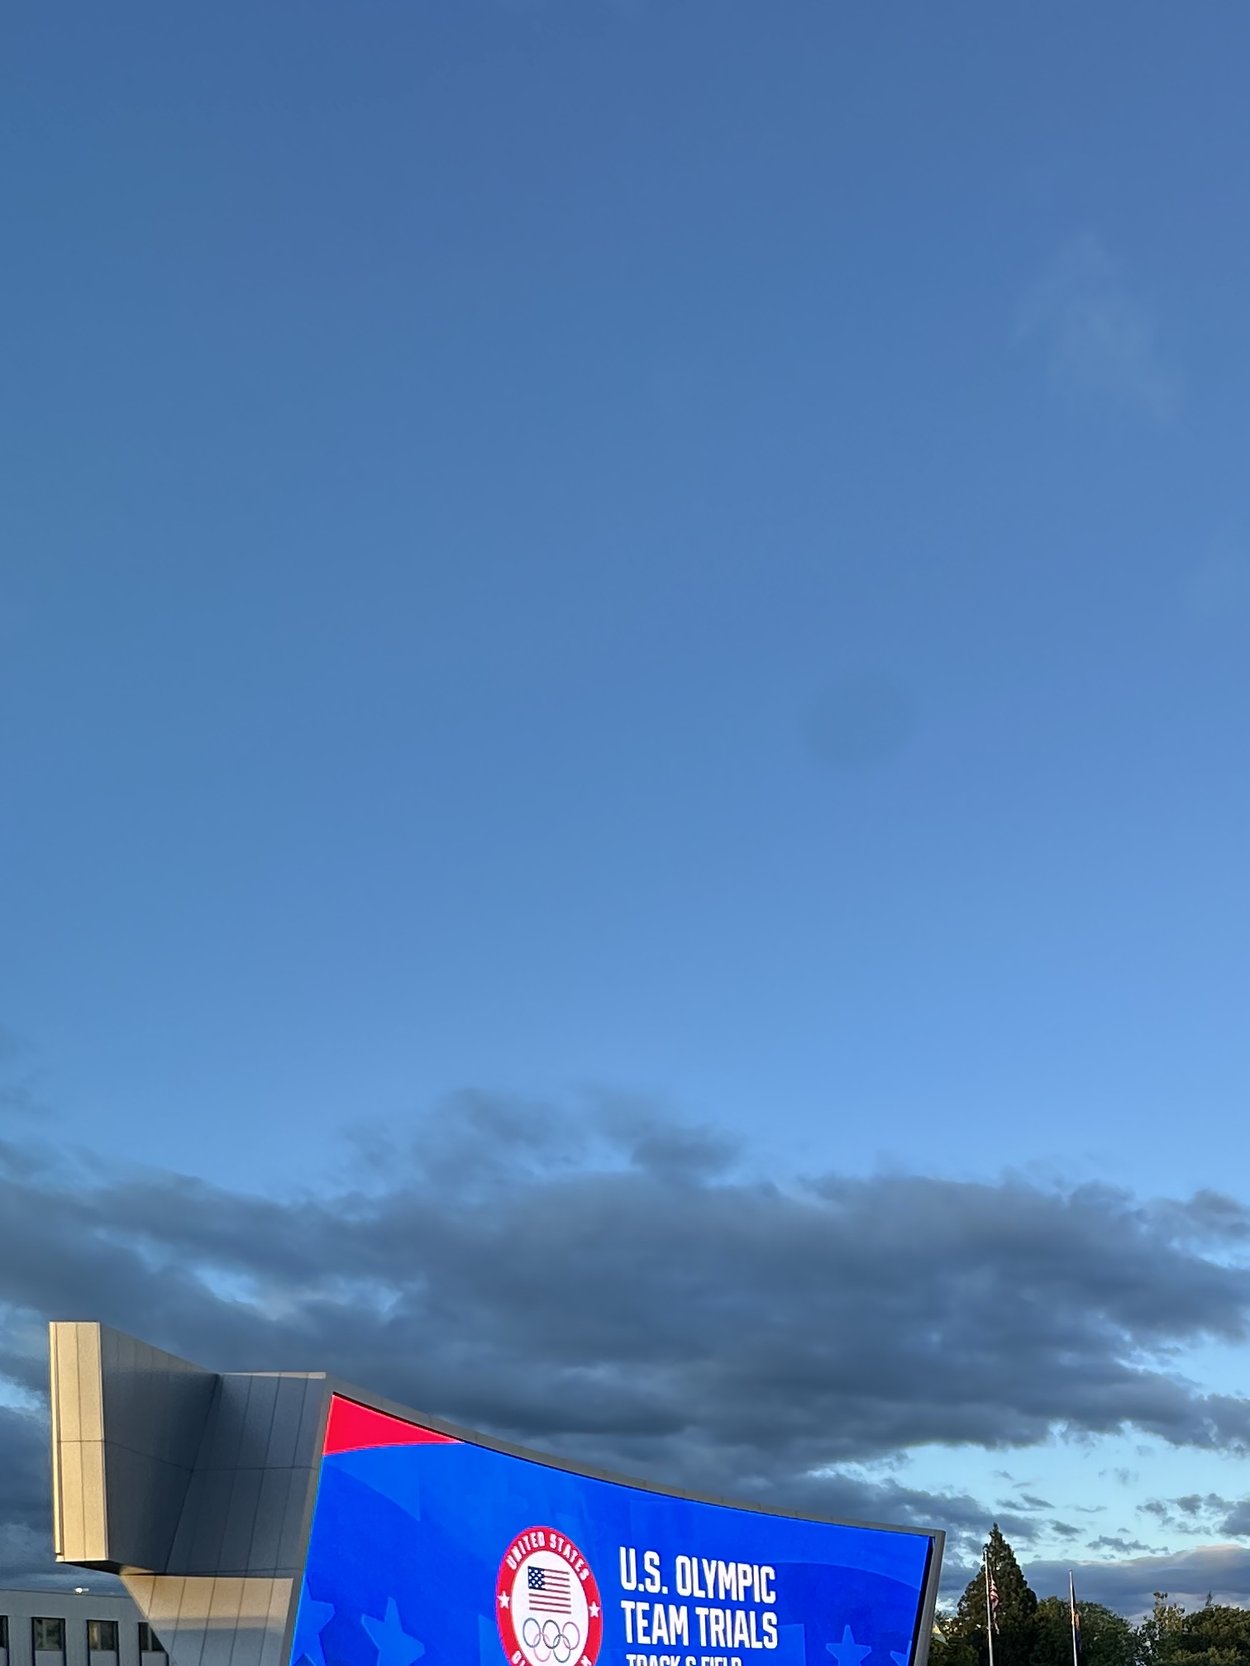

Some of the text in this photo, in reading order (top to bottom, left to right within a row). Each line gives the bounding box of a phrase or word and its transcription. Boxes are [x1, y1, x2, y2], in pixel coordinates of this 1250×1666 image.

[506, 1531, 590, 1581] UNITED STATES
[619, 1546, 777, 1604] U.S. OLYMPIC
[620, 1600, 778, 1649] TEAM TRIALS
